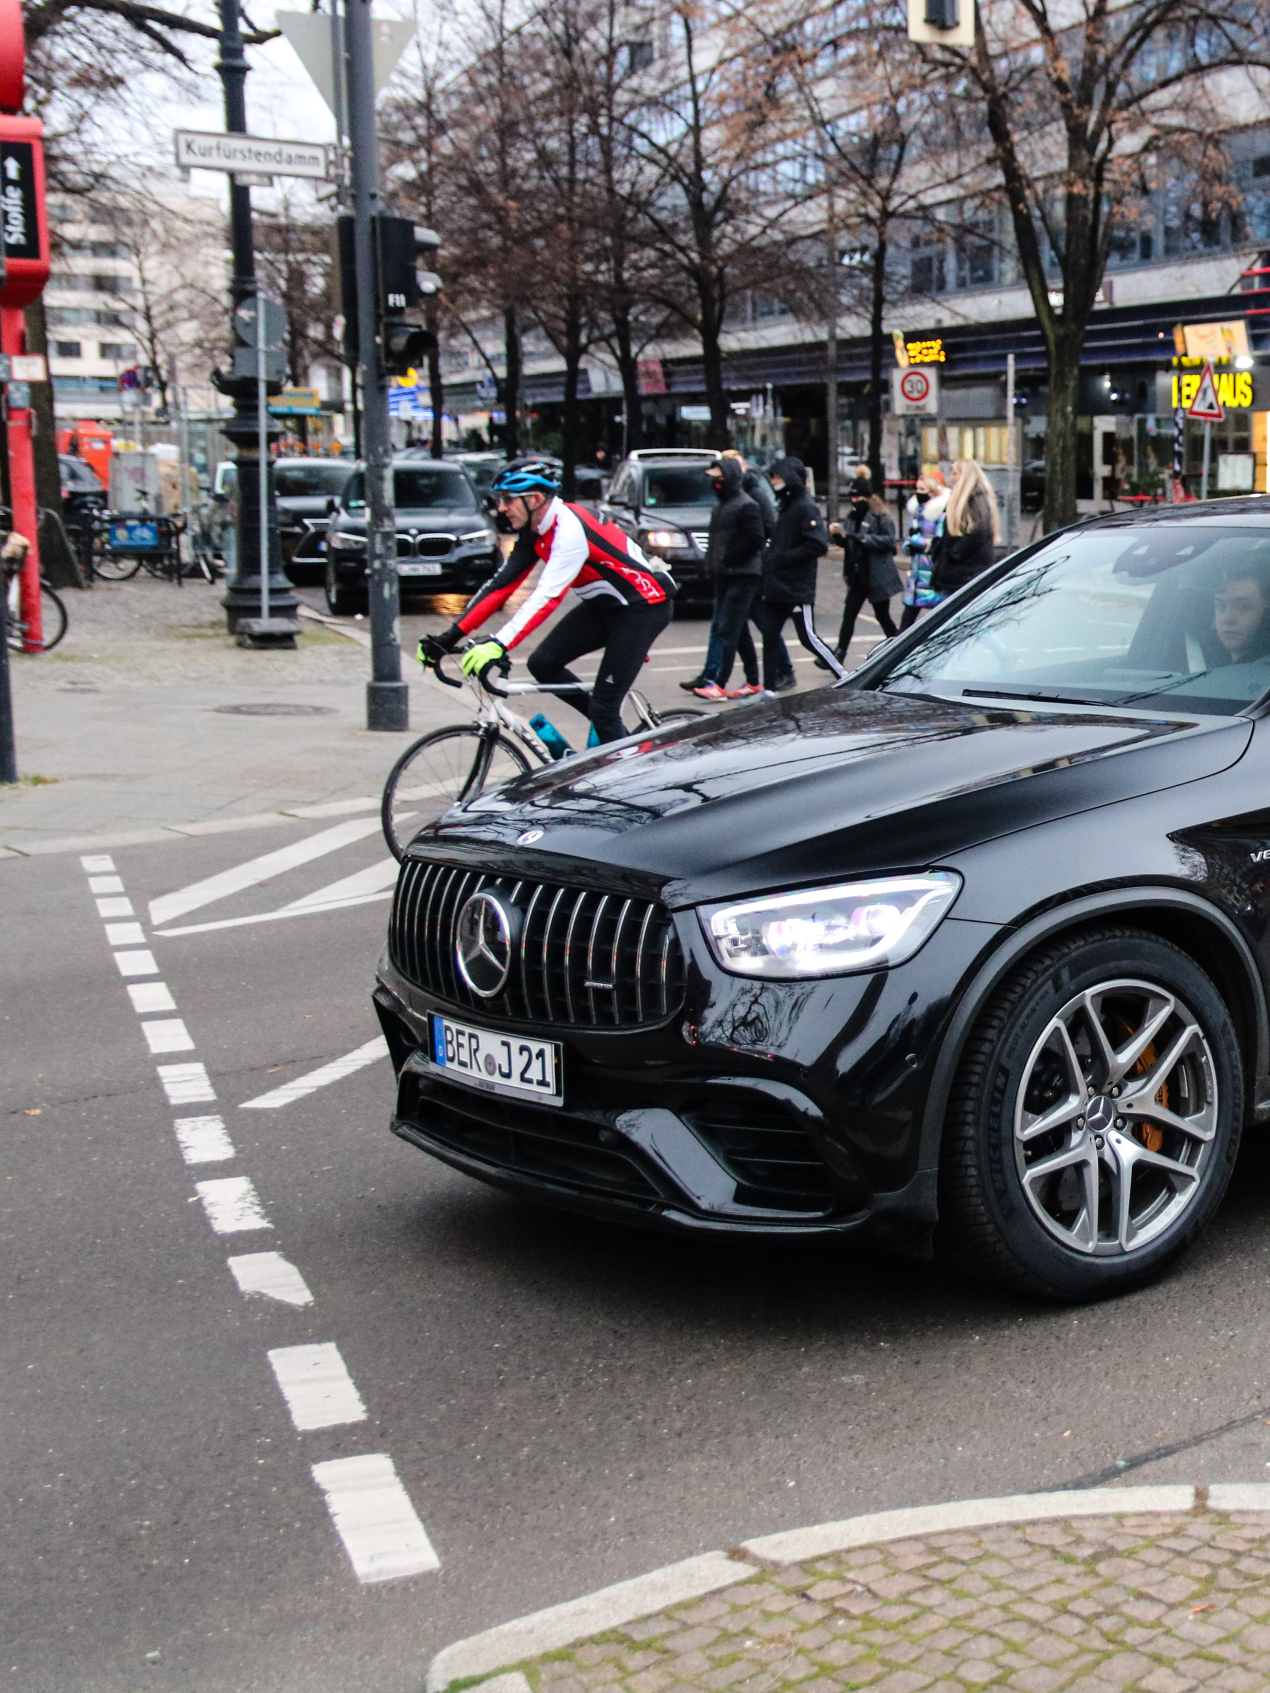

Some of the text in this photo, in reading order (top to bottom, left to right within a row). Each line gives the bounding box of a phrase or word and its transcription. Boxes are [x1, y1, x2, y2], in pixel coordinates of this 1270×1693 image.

[185, 138, 321, 168] Kurfürstendamm
[1, 184, 27, 245] Stoffe
[388, 293, 406, 308] F11
[906, 379, 924, 395] 30
[445, 1024, 551, 1088] BER J 21
